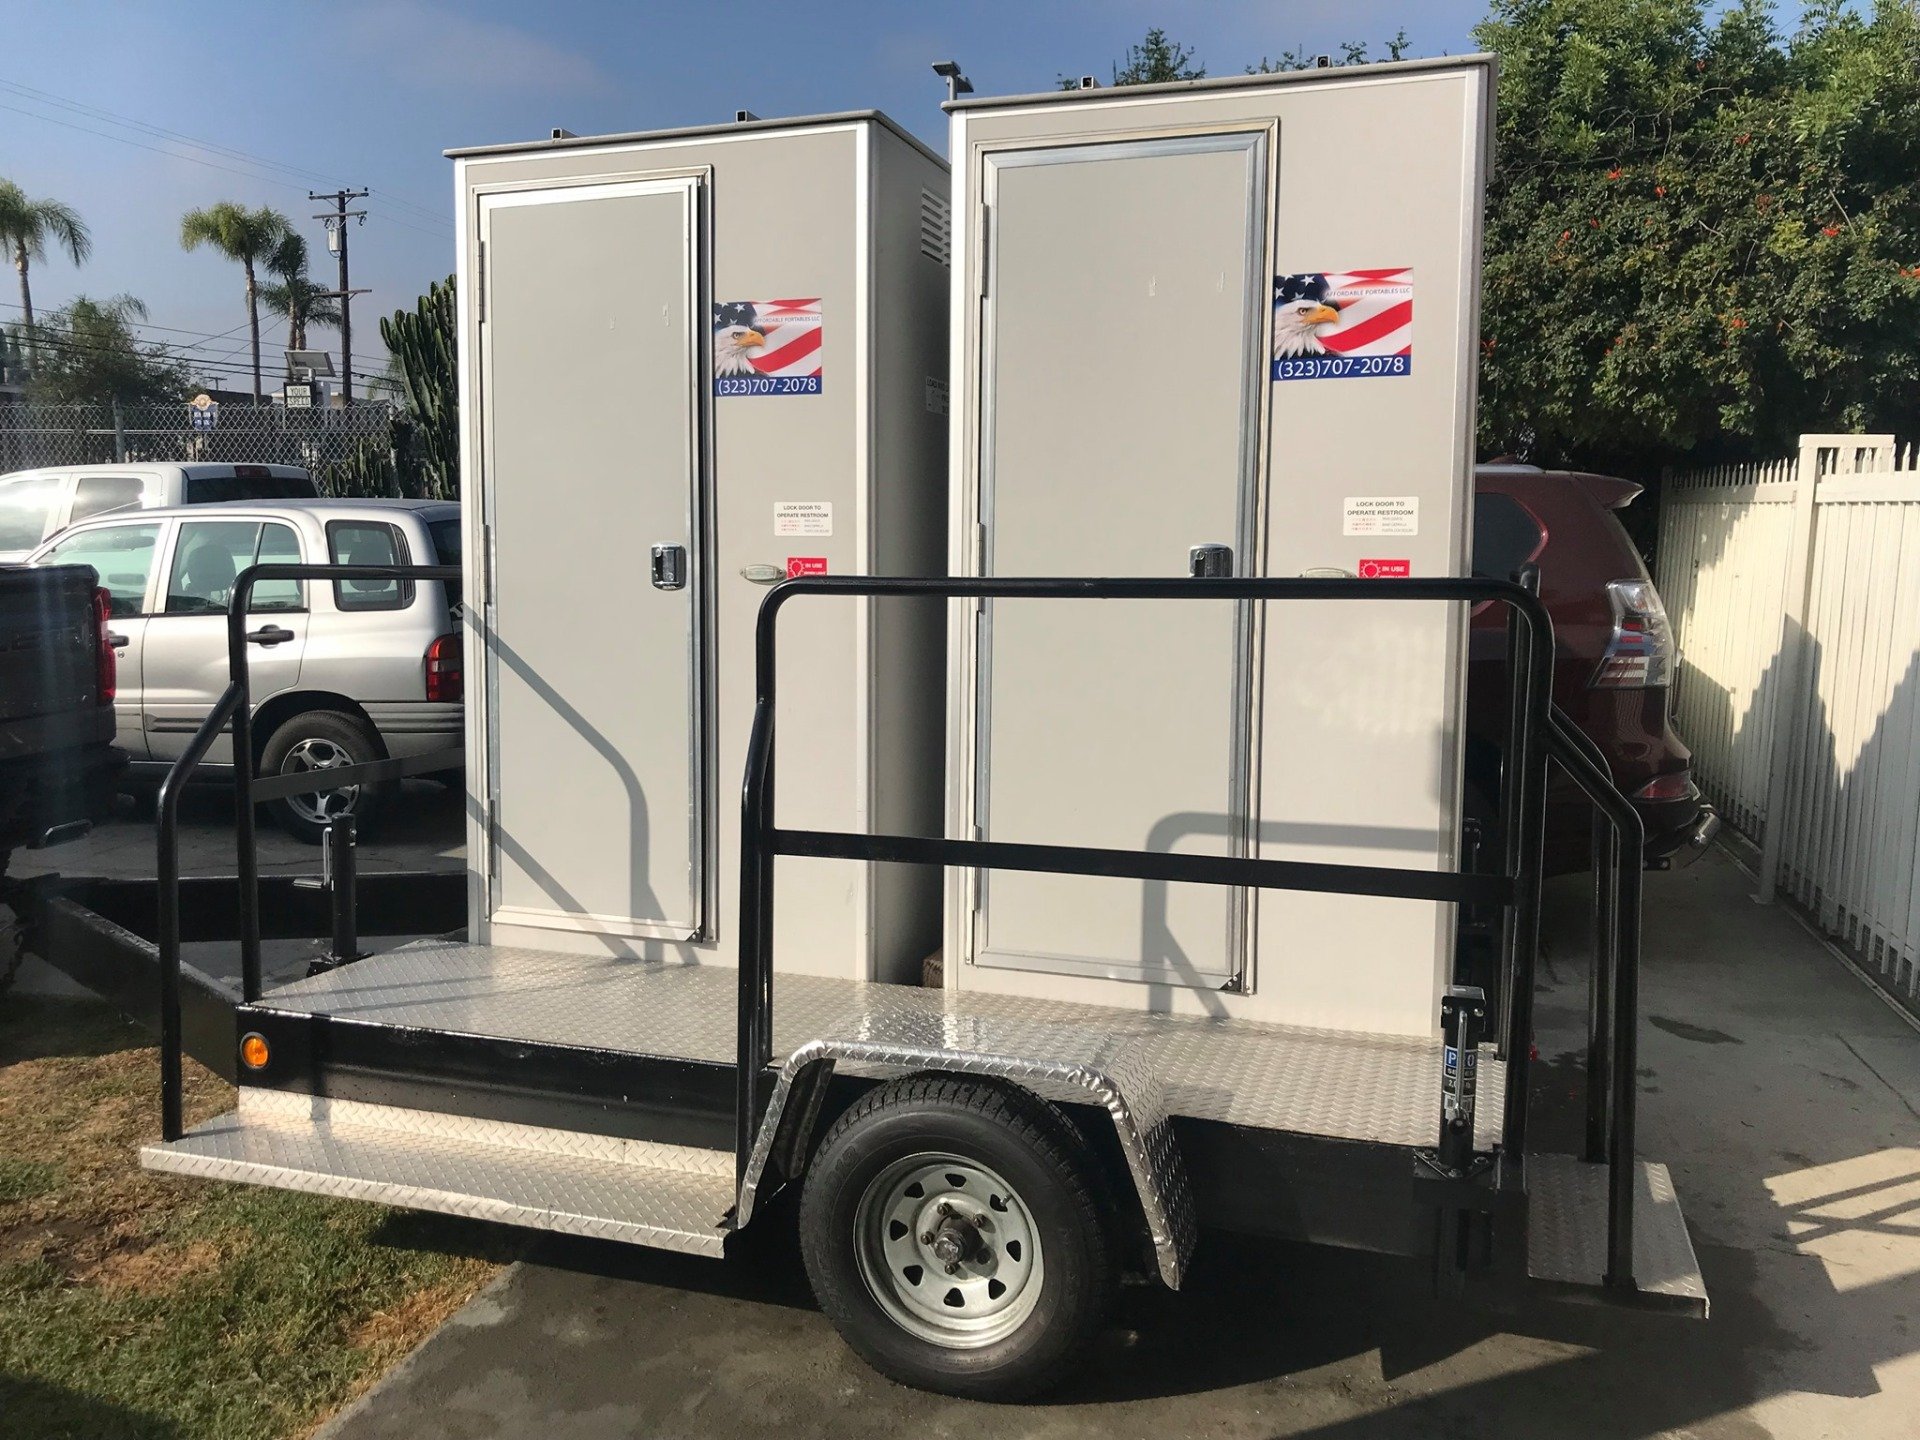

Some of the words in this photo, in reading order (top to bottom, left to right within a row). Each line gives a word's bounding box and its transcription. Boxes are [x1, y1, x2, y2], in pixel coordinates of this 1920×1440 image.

[1278, 357, 1405, 379] (323)707-2078
[290, 387, 308, 396] YOUR
[718, 377, 817, 395] (323)707-2078
[1448, 1051, 1475, 1067] PO
